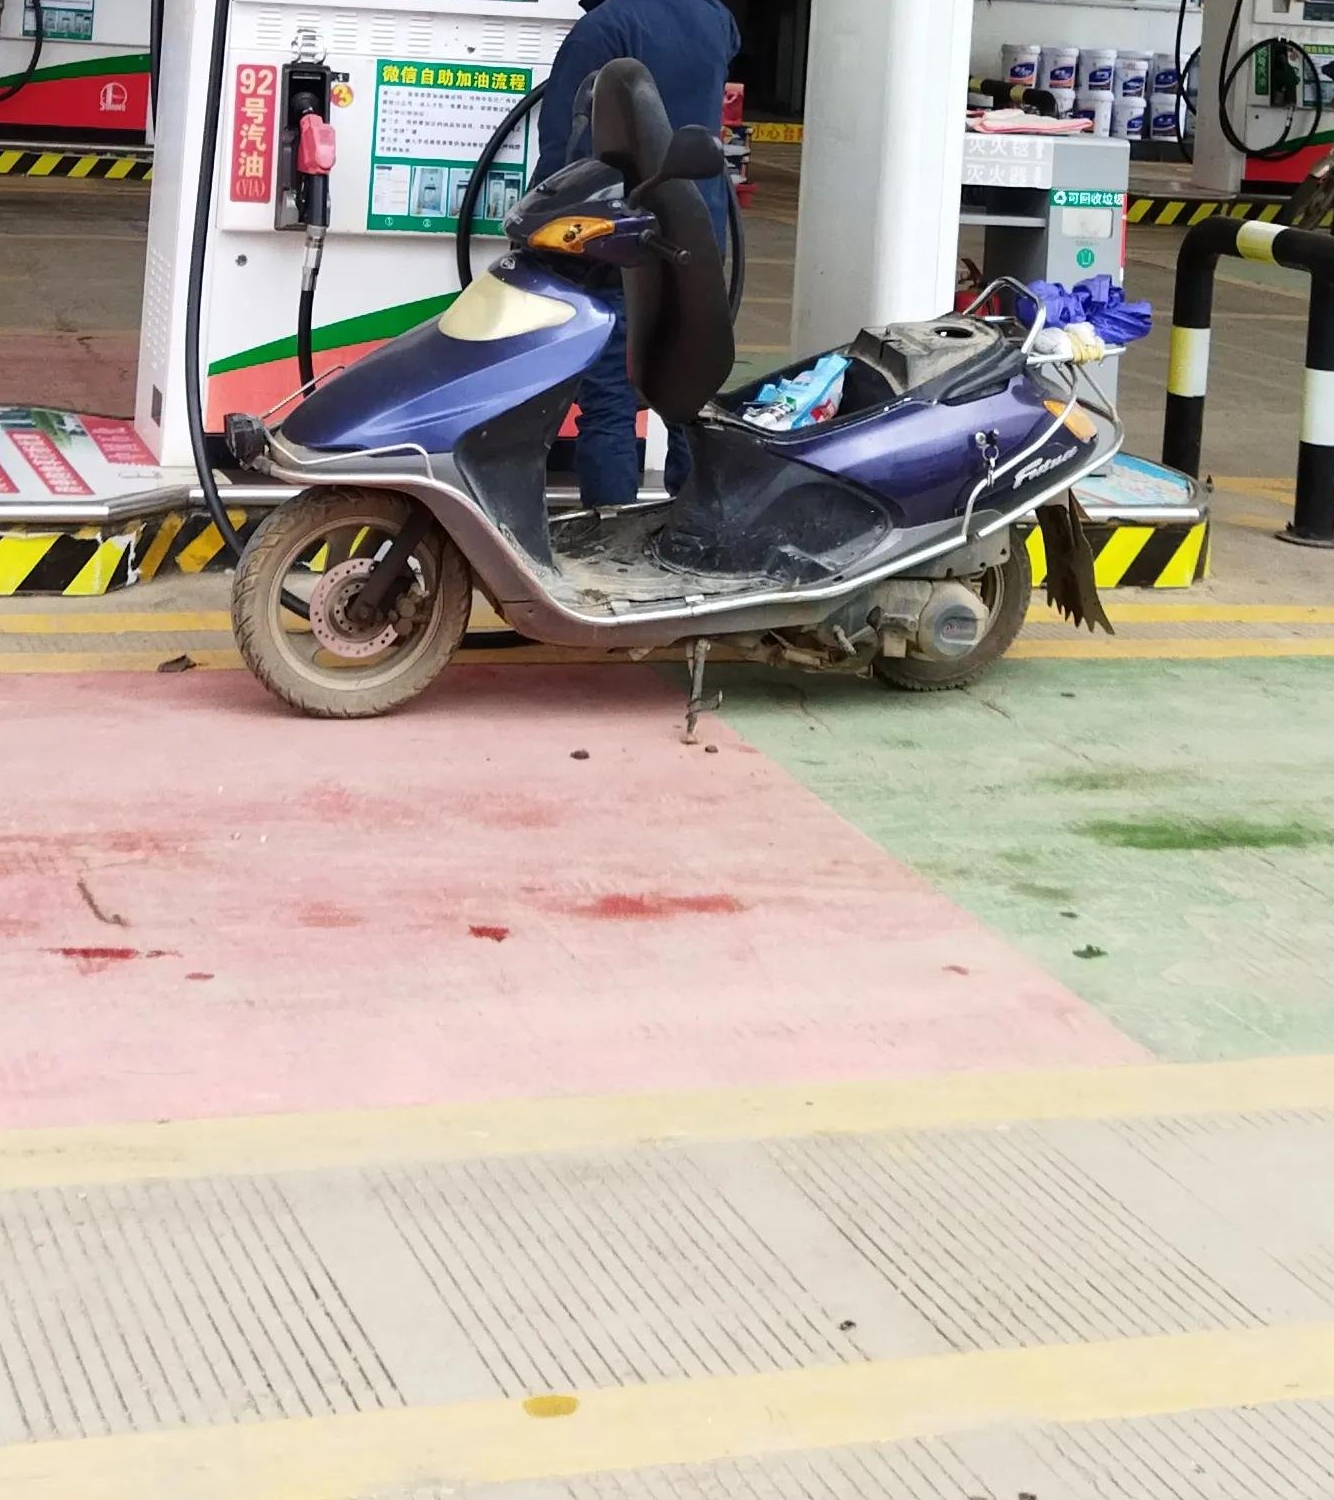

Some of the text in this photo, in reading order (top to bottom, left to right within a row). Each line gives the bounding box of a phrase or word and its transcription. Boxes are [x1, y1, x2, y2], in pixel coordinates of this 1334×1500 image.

[382, 64, 526, 92] 微信自助加油流程
[238, 67, 275, 179] 92号汽油
[966, 164, 1031, 186] 灭火器
